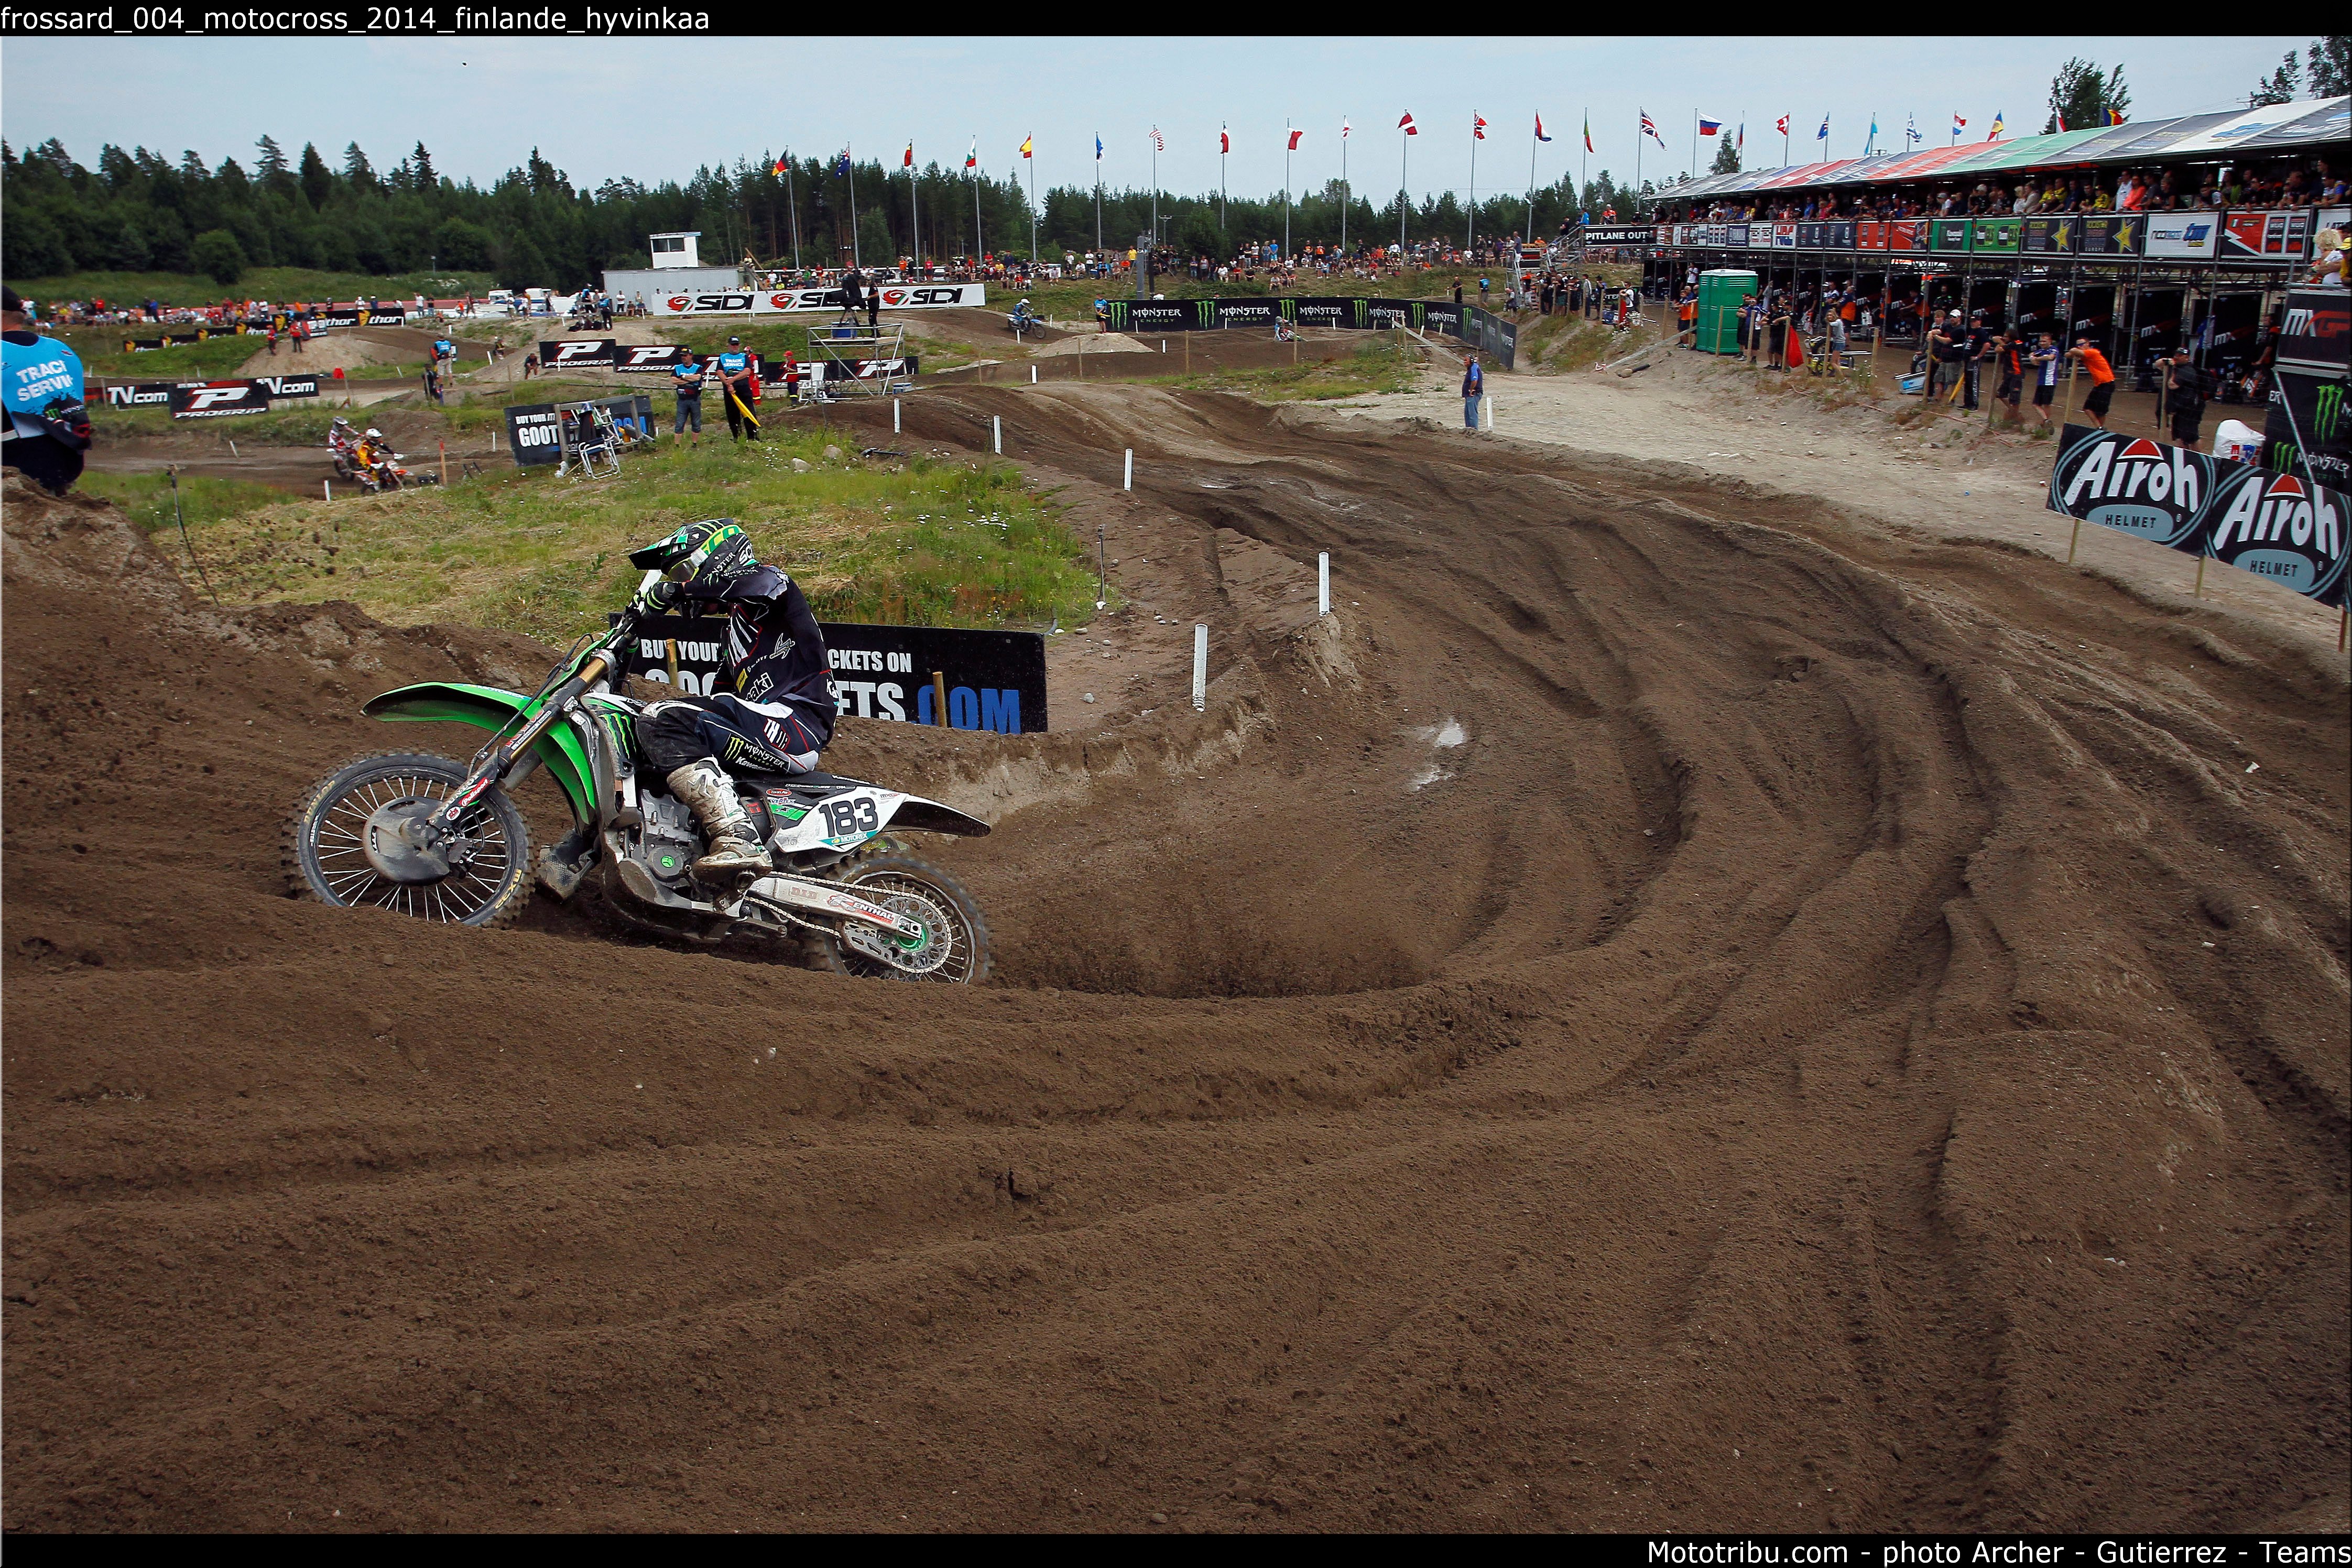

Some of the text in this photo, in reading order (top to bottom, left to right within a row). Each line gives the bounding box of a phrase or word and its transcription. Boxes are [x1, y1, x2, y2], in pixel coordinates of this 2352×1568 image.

[1585, 231, 1625, 240] PITLANE
[1628, 231, 1647, 239] OUT
[694, 295, 755, 310] SIDI
[910, 288, 964, 304] SIDI
[1133, 308, 1182, 318] MONSTER
[1219, 306, 1270, 317] MONSTER
[1300, 306, 1342, 315] MONSTER
[1428, 311, 1457, 323] MONSTER
[175, 408, 267, 418] PROGRIP
[515, 415, 529, 424] BUY
[529, 413, 547, 423] YOUR
[2063, 441, 2198, 513] Airoh
[2106, 514, 2157, 529] HELMET
[2213, 477, 2339, 561] Airoh
[2250, 560, 2298, 578] HELMET
[887, 652, 912, 673] ON
[537, 711, 551, 725] Touch
[744, 743, 785, 768] MONSTER
[461, 779, 488, 807] Polisport
[819, 797, 879, 837] 183
[841, 832, 868, 842] MOTOREX
